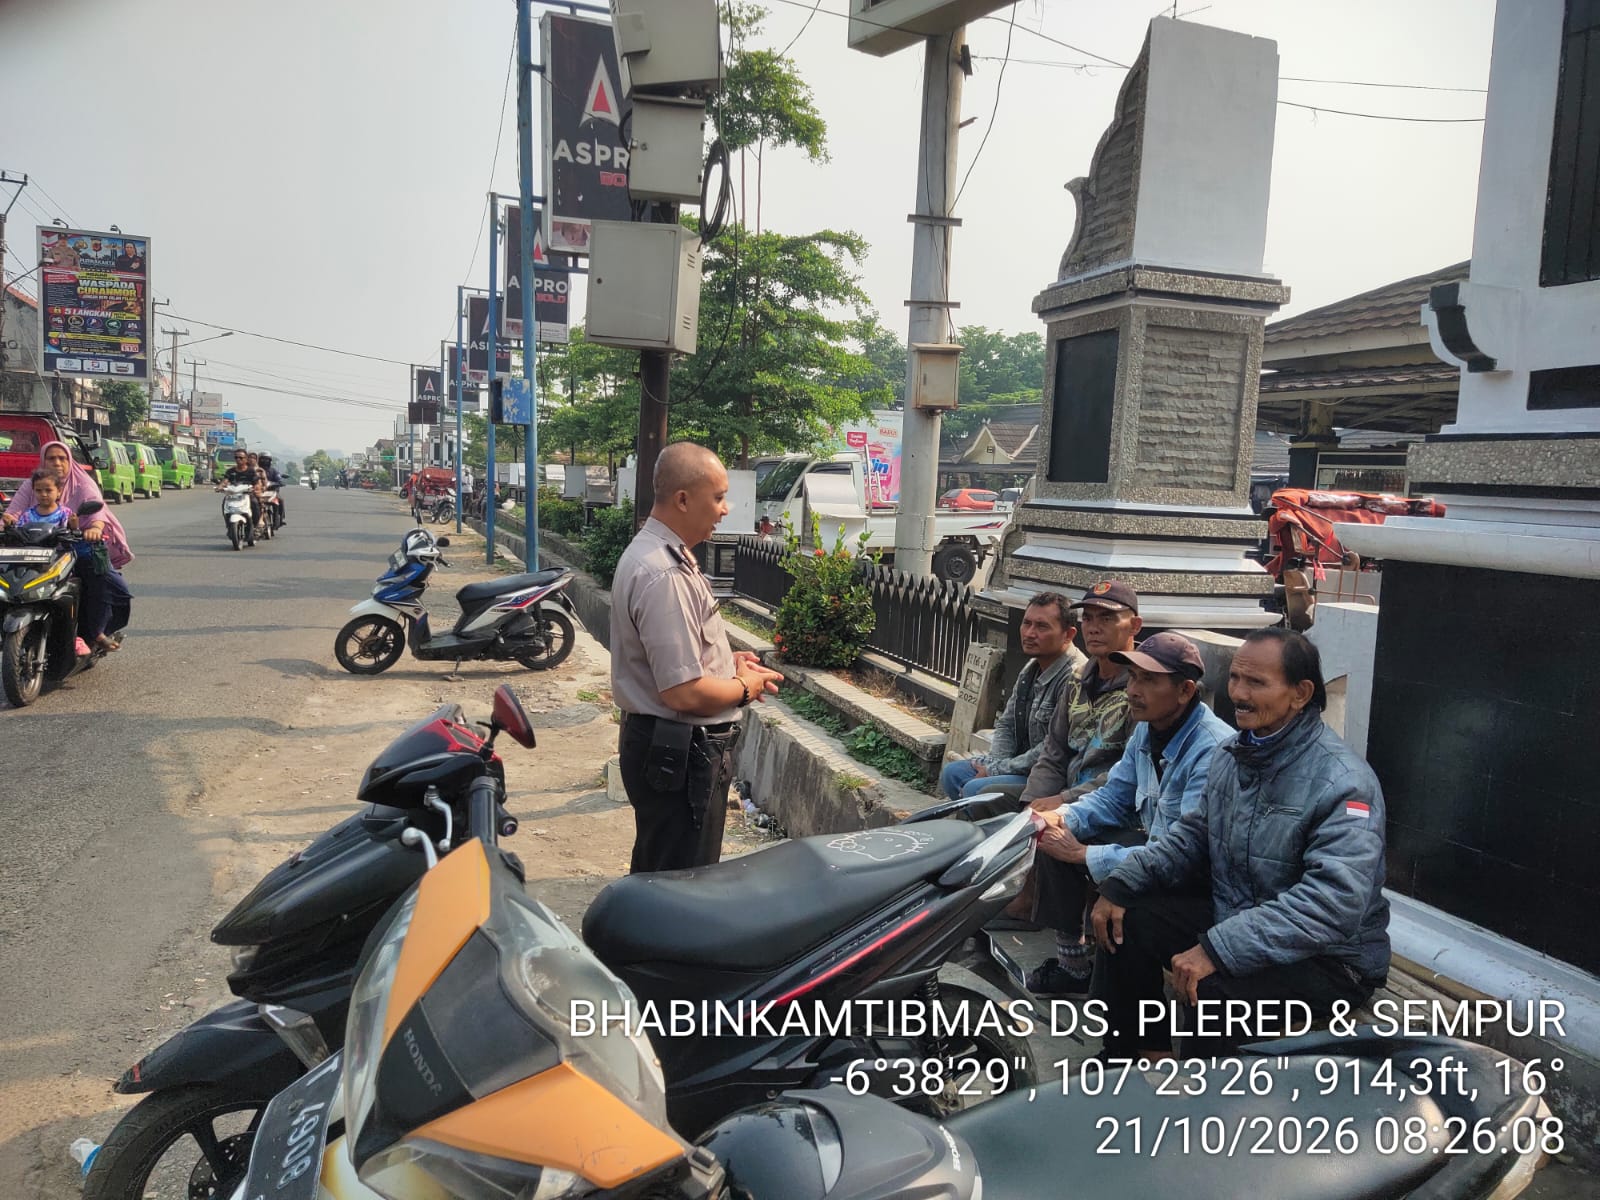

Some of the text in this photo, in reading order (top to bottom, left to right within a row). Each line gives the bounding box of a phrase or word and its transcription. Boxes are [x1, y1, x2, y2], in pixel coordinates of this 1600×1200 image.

[553, 139, 630, 169] ASPR
[79, 280, 135, 290] WASPADA
[508, 275, 568, 294] APRO
[72, 308, 112, 318] LANGKAH
[958, 690, 977, 705] 2022
[403, 1027, 443, 1097] HONDA
[277, 1102, 325, 1189] 4908
